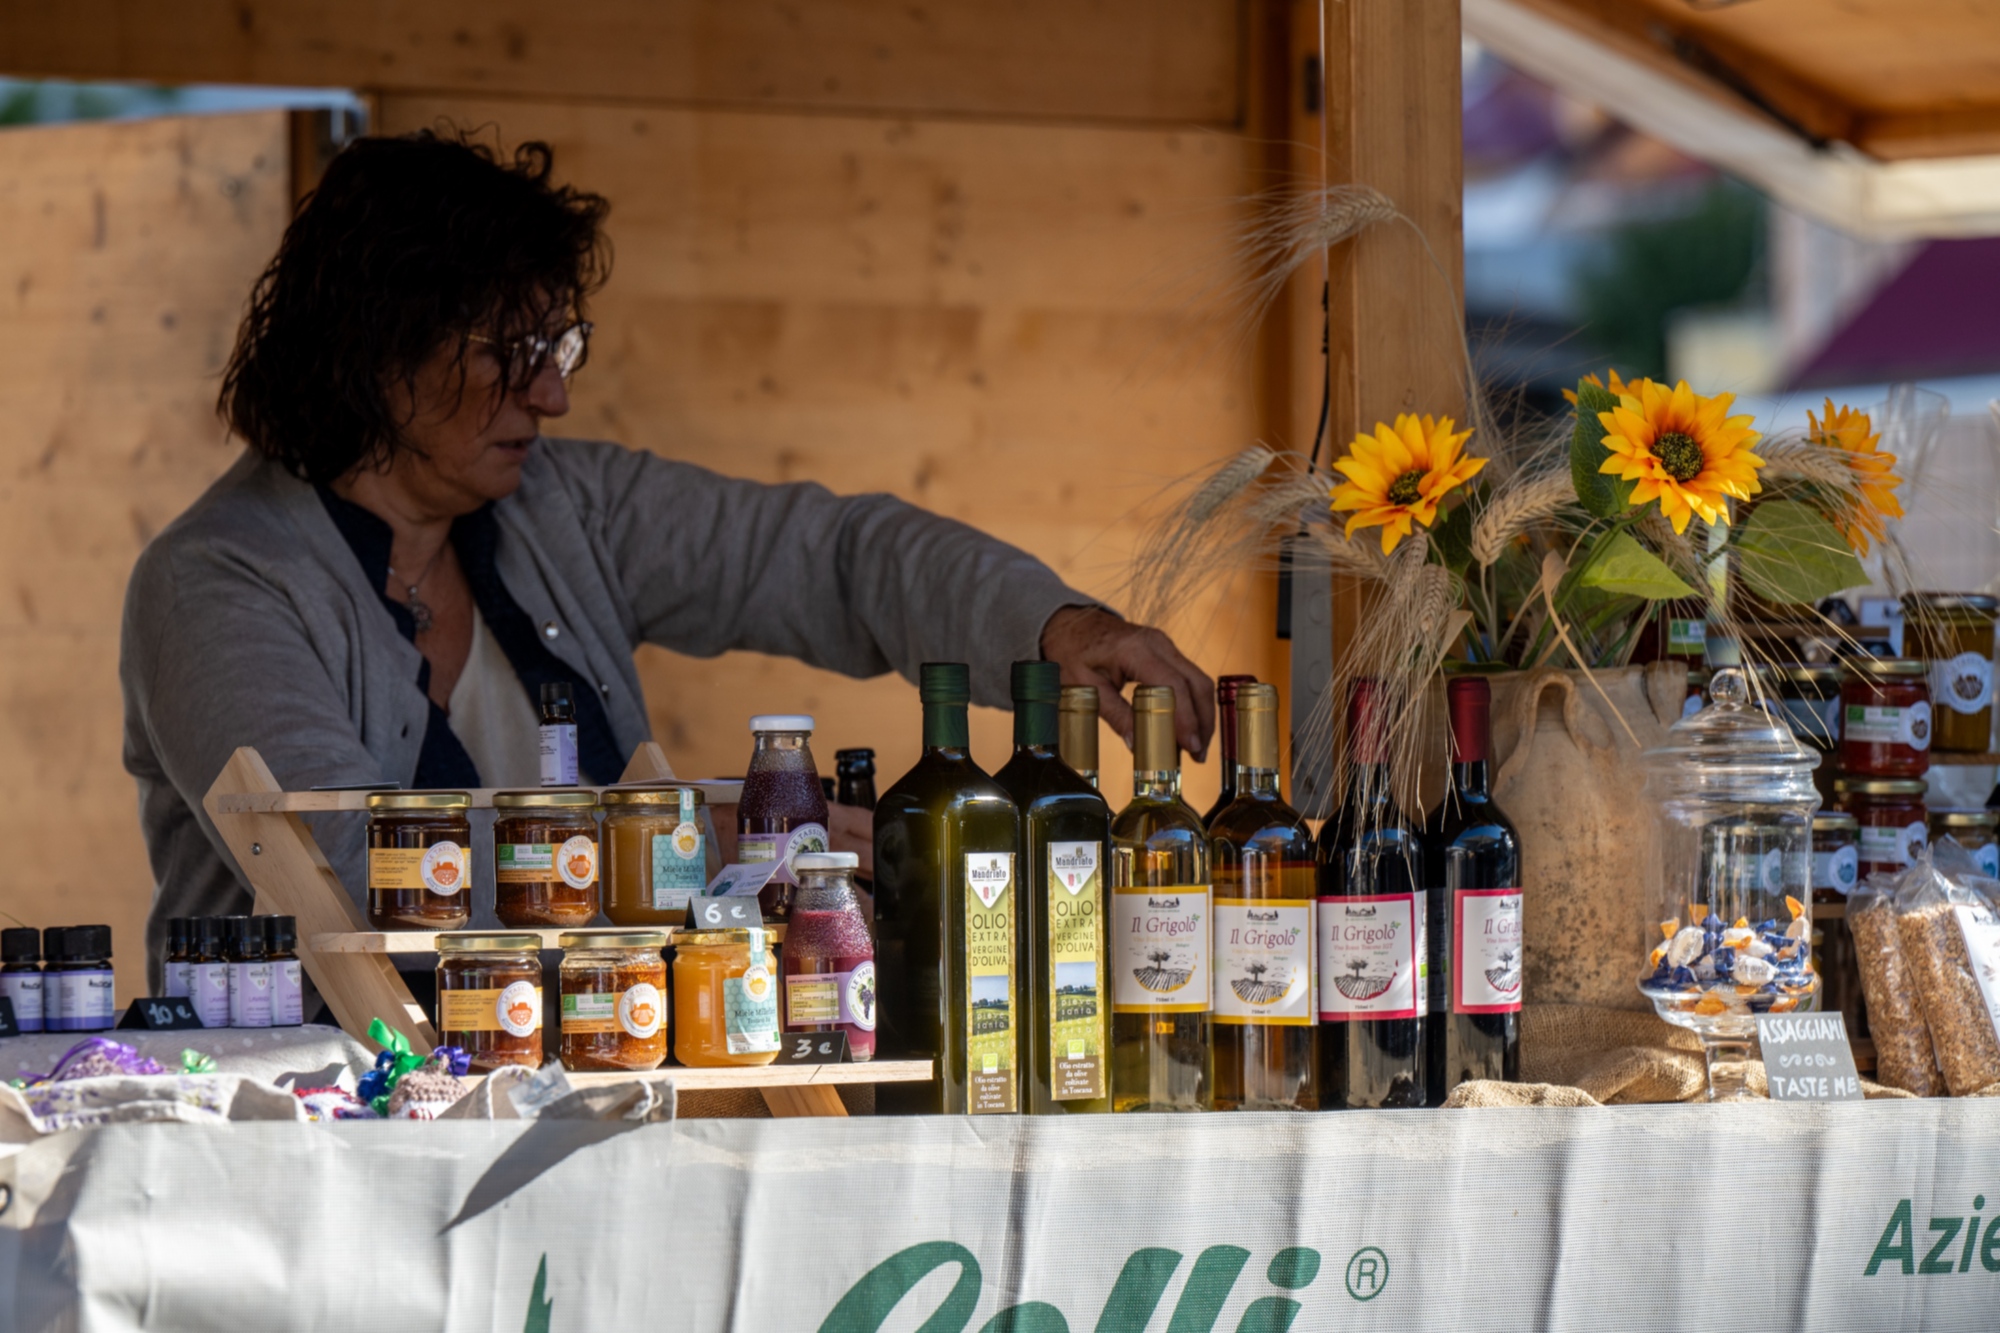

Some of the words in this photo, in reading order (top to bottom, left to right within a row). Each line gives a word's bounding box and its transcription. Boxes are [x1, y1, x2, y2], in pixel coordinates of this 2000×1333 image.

[705, 903, 722, 923] 6
[1056, 900, 1094, 916] OLIO
[972, 913, 1007, 930] OLIO
[1056, 918, 1094, 929] EXTRA
[1131, 916, 1141, 933] Il
[1484, 918, 1494, 934] Il
[972, 931, 1007, 942] EXTRA
[1056, 932, 1094, 943] VERGINE
[1230, 928, 1240, 944] Il
[1331, 925, 1340, 941] Il
[972, 945, 1007, 954] VERGINE
[1056, 942, 1094, 953] D'OLIVA
[972, 956, 1008, 966] D'OLIVA
[1061, 998, 1092, 1007] pieve
[1061, 1007, 1092, 1016] santa
[976, 1021, 1005, 1030] santa
[1760, 1018, 1846, 1044] ASSAGGIAMI
[791, 1038, 812, 1059] 3
[1075, 1069, 1088, 1077] olive
[1065, 1078, 1089, 1086] coltivate
[1772, 1076, 1828, 1097] TASTE
[1834, 1076, 1857, 1097] ME
[981, 1084, 988, 1092] da
[1070, 1086, 1093, 1094] Toscana
[980, 1092, 1002, 1100] coltivate
[977, 1101, 983, 1109] in
[984, 1101, 1006, 1109] Toscana
